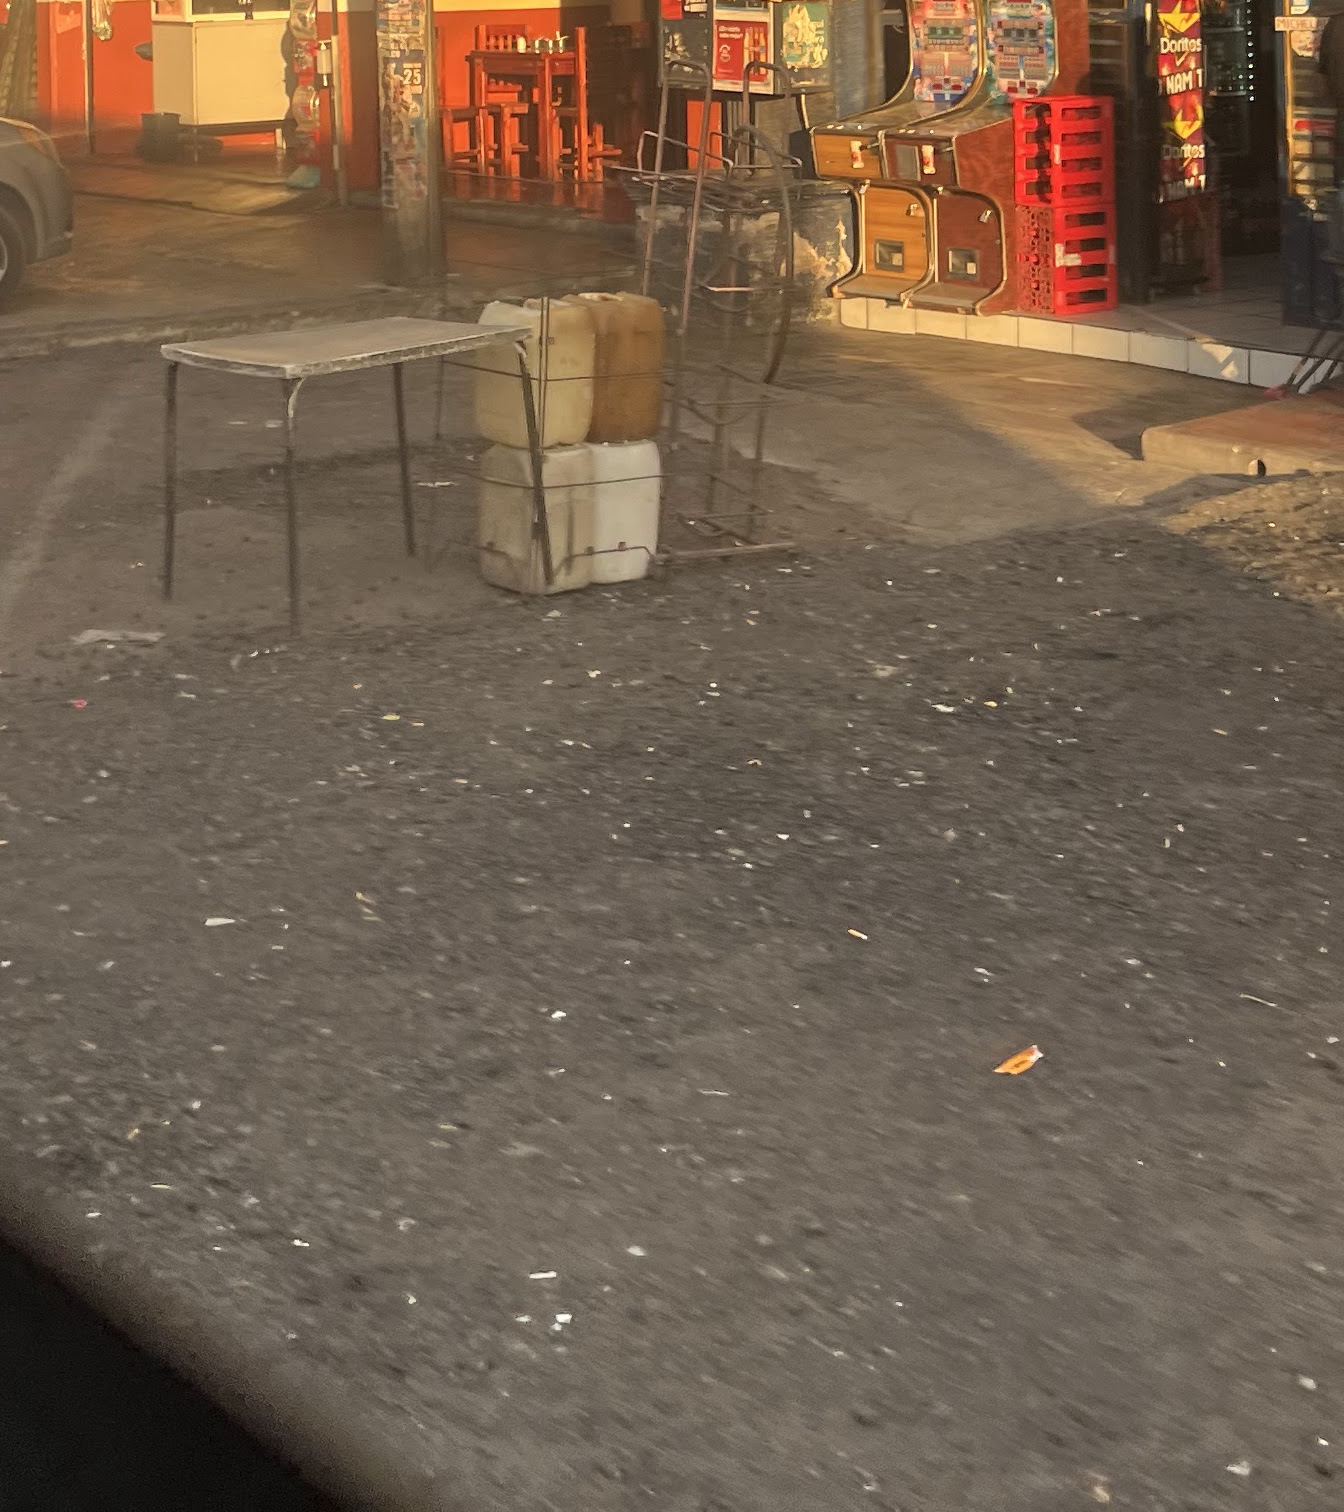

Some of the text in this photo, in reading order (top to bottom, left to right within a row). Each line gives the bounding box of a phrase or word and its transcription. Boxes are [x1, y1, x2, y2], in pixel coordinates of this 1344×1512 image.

[1159, 37, 1203, 54] Doritos
[402, 68, 422, 85] 25
[1161, 143, 1206, 159] Doritos
